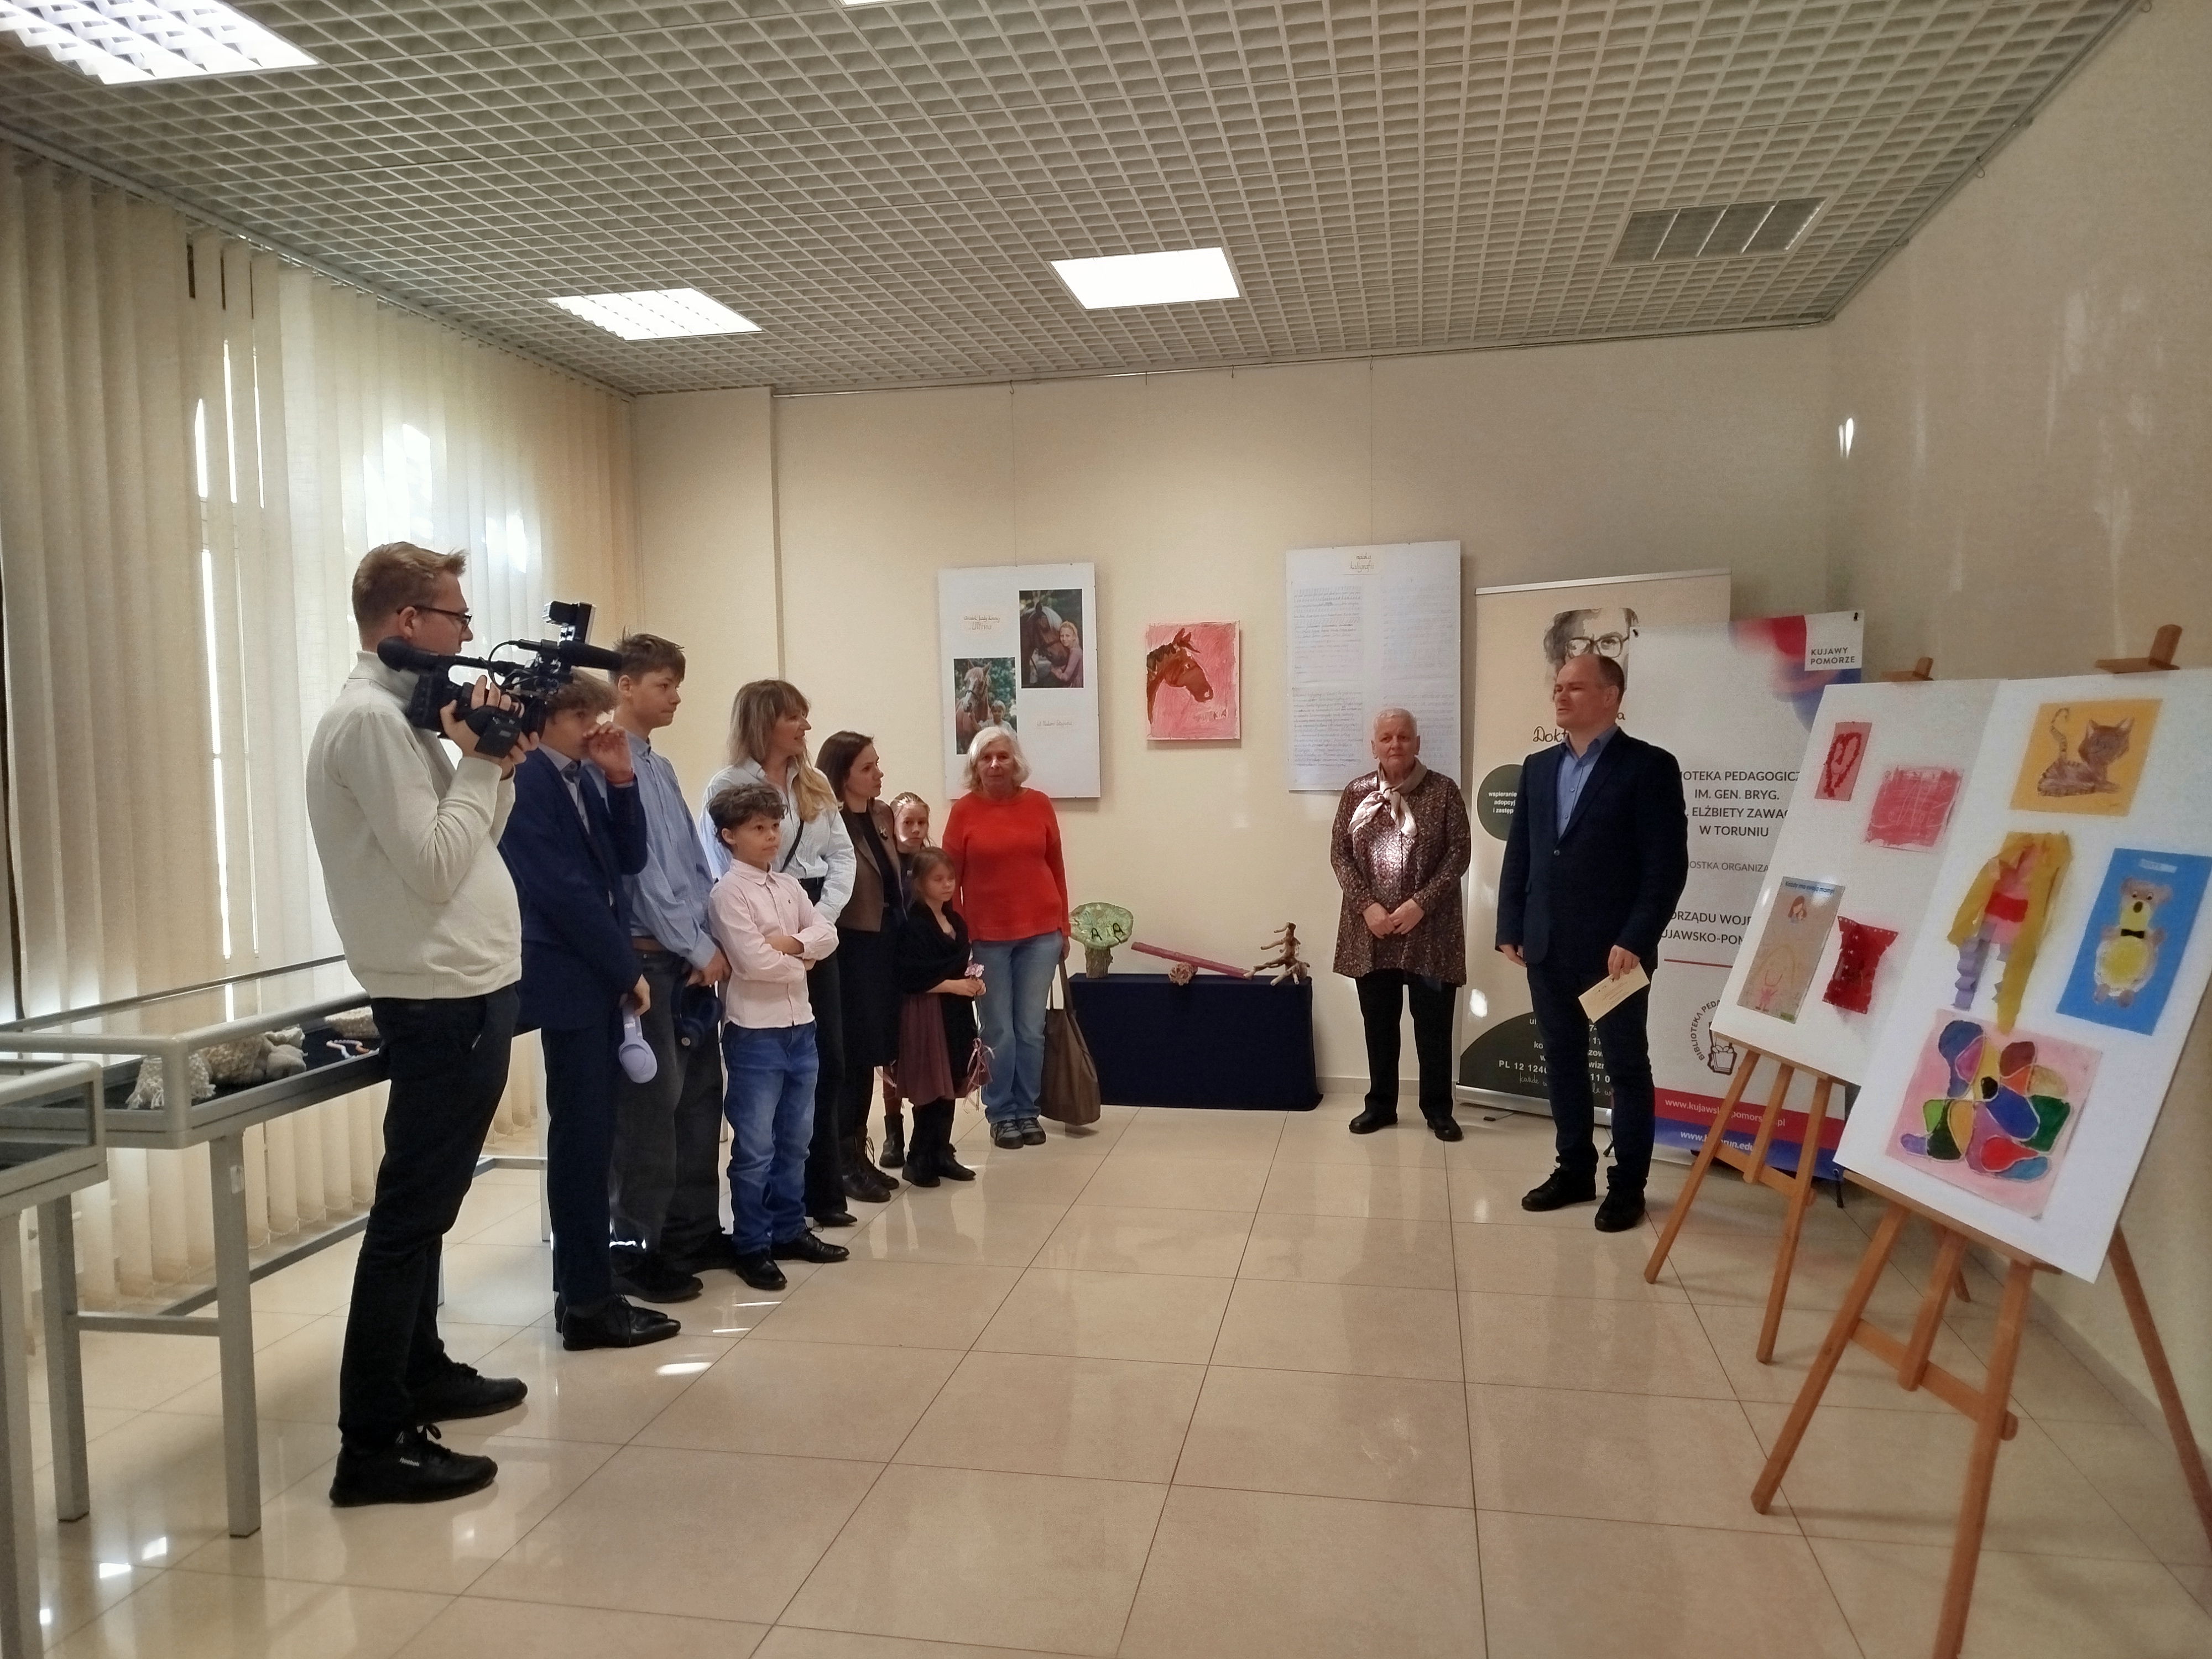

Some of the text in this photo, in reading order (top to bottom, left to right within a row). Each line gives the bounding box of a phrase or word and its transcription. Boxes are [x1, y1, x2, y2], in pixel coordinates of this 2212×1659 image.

[1811, 647, 1848, 656] KUJAWY
[1810, 656, 1855, 665] POMORZE
[1532, 726, 1567, 742] Dokt
[1680, 771, 1722, 781] OTEKA
[1694, 789, 1780, 800] IM. GEN. BRYG.
[1692, 805, 1745, 818] ELŻBIETY
[1699, 825, 1769, 837] W TORUNIU
[1689, 860, 1768, 872] OSTKA ORGANIZA
[1672, 910, 1717, 924] RZĄDU
[1661, 929, 1743, 945] UJAWSKO-PO
[1690, 999, 1720, 1061] BIBLIOTEKA PEDA
[1499, 1060, 1510, 1069] PL
[1514, 1062, 1525, 1071] 12
